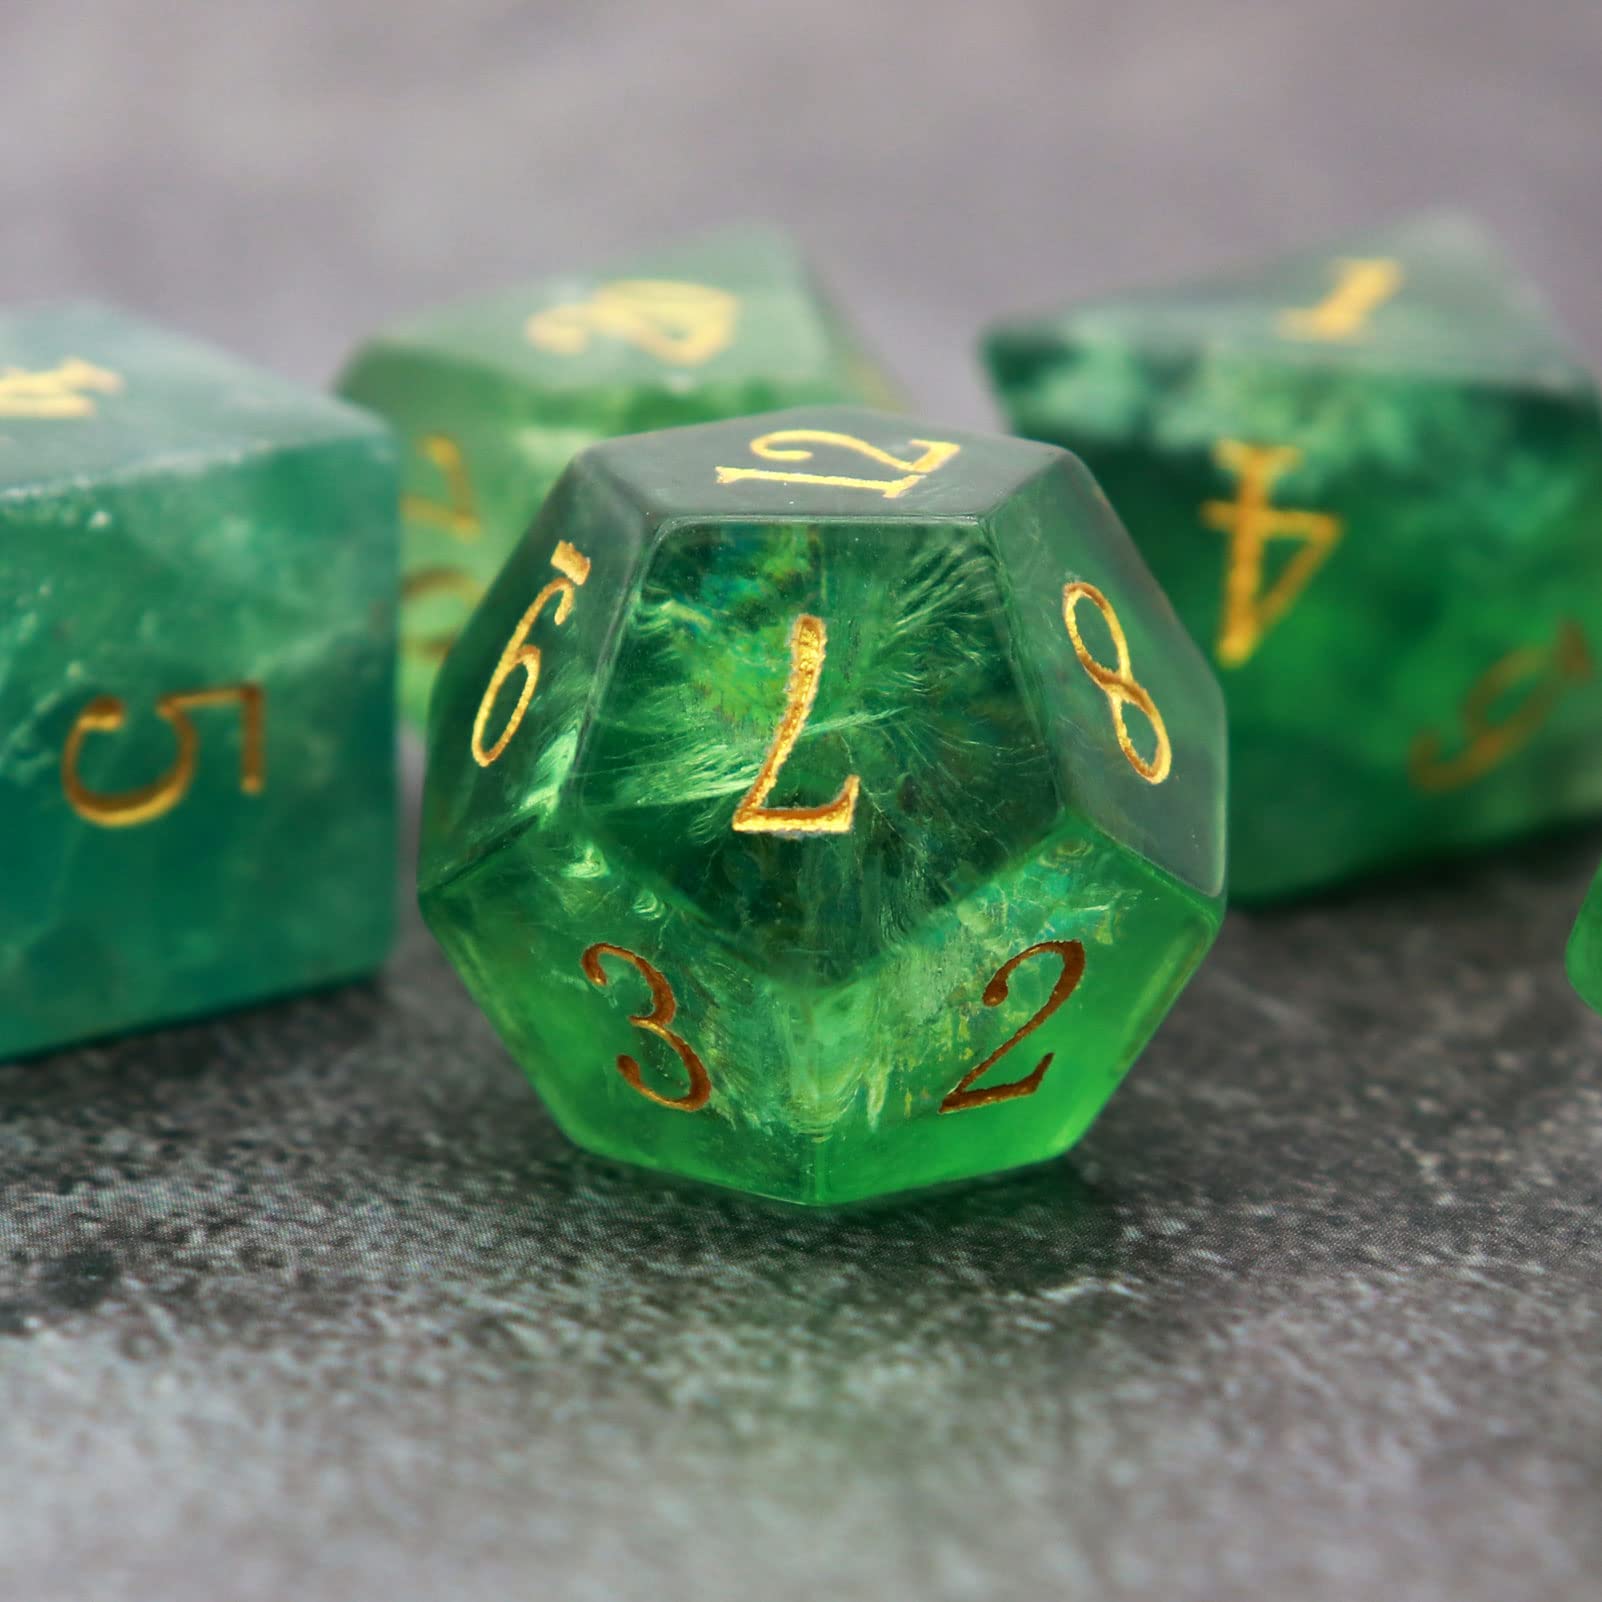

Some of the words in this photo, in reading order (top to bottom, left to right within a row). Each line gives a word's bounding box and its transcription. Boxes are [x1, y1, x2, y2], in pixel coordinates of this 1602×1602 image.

[715, 429, 960, 499] 12
[1202, 438, 1342, 668] 4
[61, 683, 265, 827] 5
[732, 614, 860, 834] 7
[1063, 582, 1171, 785] 8
[581, 942, 711, 1113] 3
[937, 940, 1087, 1115] 2
